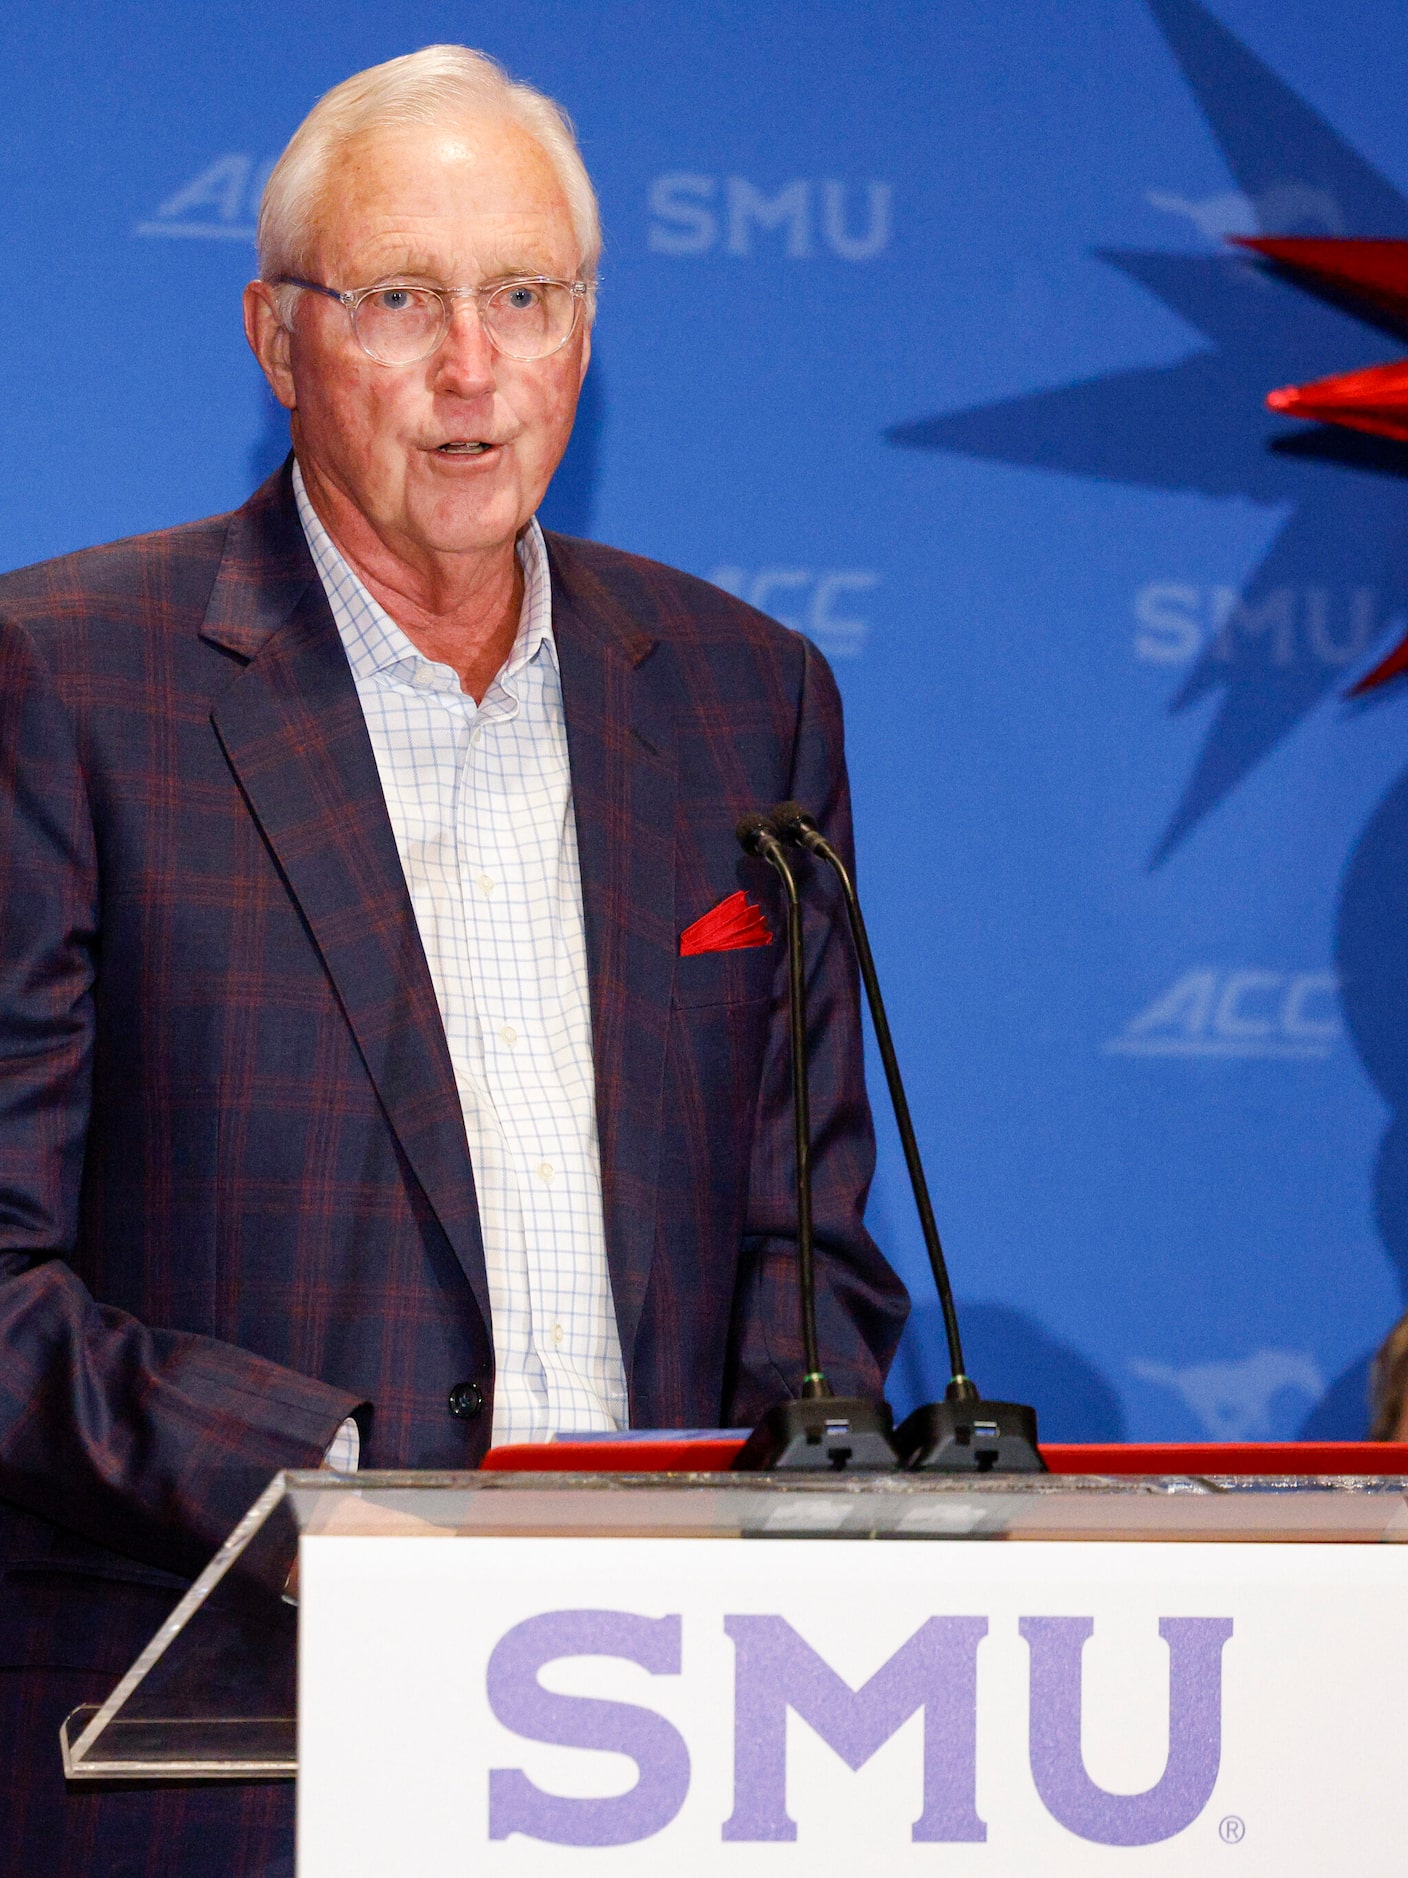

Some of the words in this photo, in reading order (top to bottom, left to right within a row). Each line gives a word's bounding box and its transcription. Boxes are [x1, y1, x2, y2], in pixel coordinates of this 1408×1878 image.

[648, 173, 894, 260] SMU
[1135, 583, 1379, 664] SMU
[1122, 967, 1344, 1037] ACC
